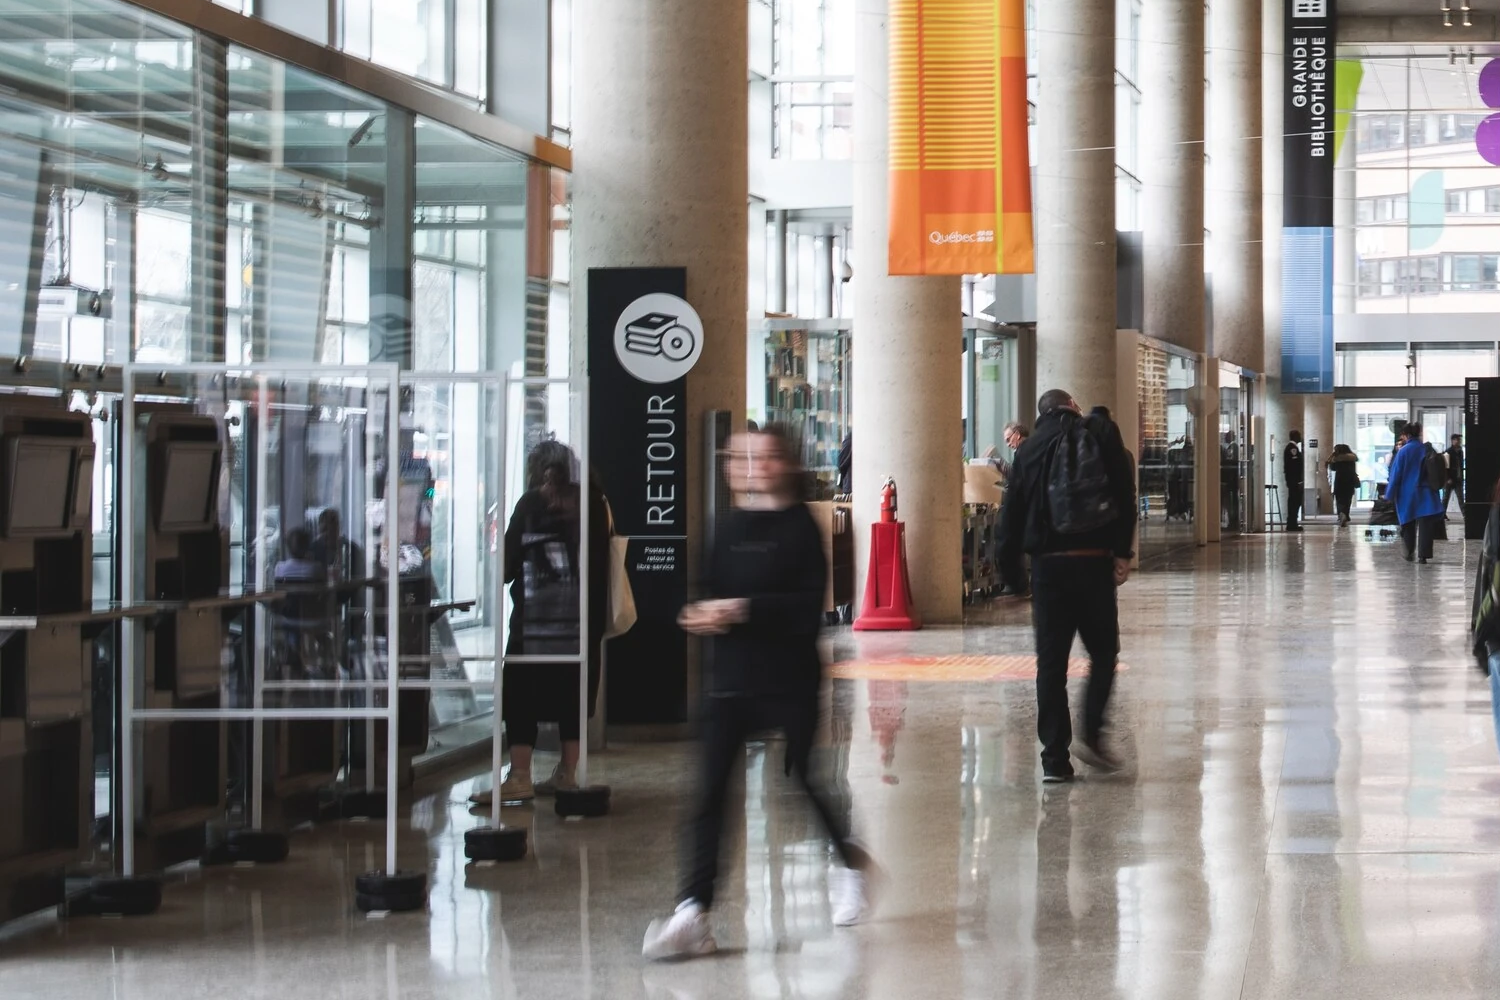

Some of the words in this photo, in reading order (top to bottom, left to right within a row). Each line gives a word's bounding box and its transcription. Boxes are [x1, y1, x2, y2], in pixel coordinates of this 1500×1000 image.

[1292, 37, 1307, 108] GRANDE
[1308, 37, 1326, 157] BIBLIOTHÈQUE
[928, 230, 976, 245] Québec
[647, 394, 675, 525] RETOUR
[666, 546, 675, 554] de
